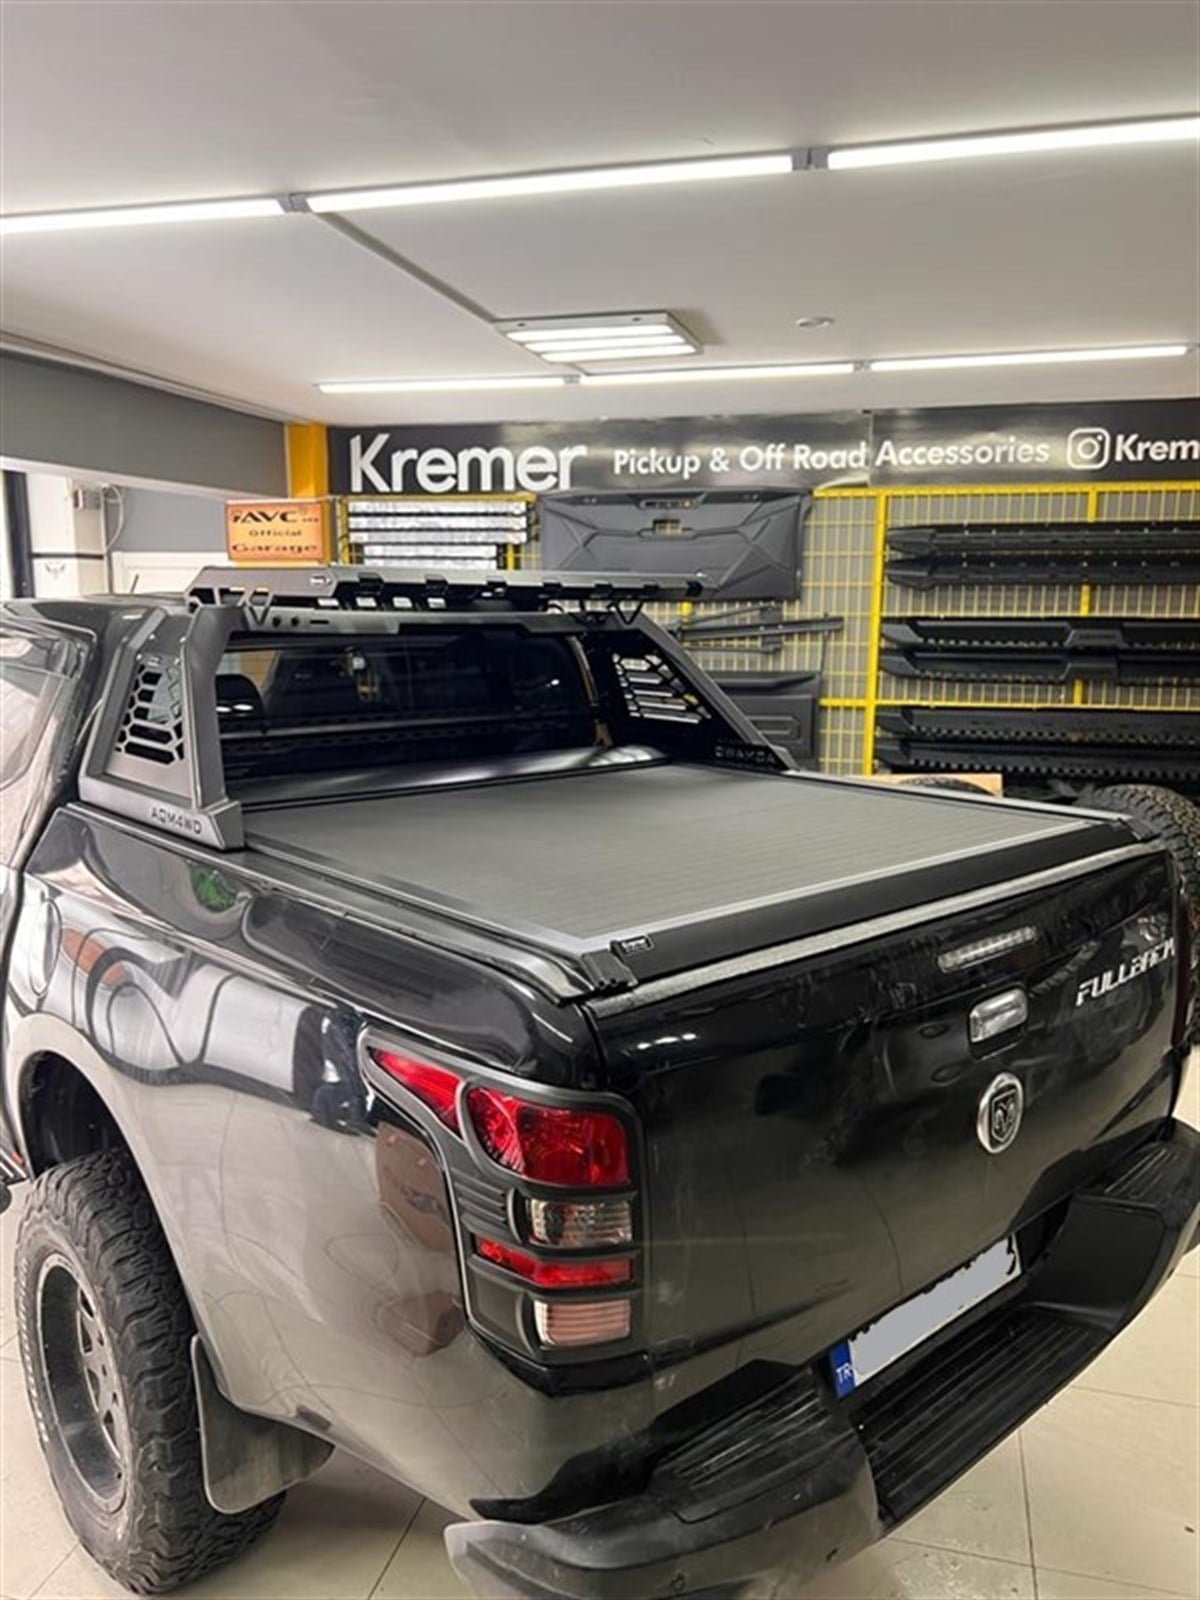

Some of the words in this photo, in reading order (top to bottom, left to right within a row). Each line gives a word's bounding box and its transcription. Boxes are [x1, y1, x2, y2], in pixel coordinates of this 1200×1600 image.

[349, 433, 588, 493] Kremer
[613, 447, 701, 480] Pickup
[708, 447, 730, 472] &
[739, 443, 787, 471] Off
[793, 440, 868, 470] Road
[874, 436, 1051, 467] Accessories
[1114, 433, 1200, 463] Krem
[248, 528, 303, 538] Official
[231, 543, 318, 554] Garage
[1075, 937, 1175, 1007] FULLBACK
[835, 1361, 853, 1384] TR
